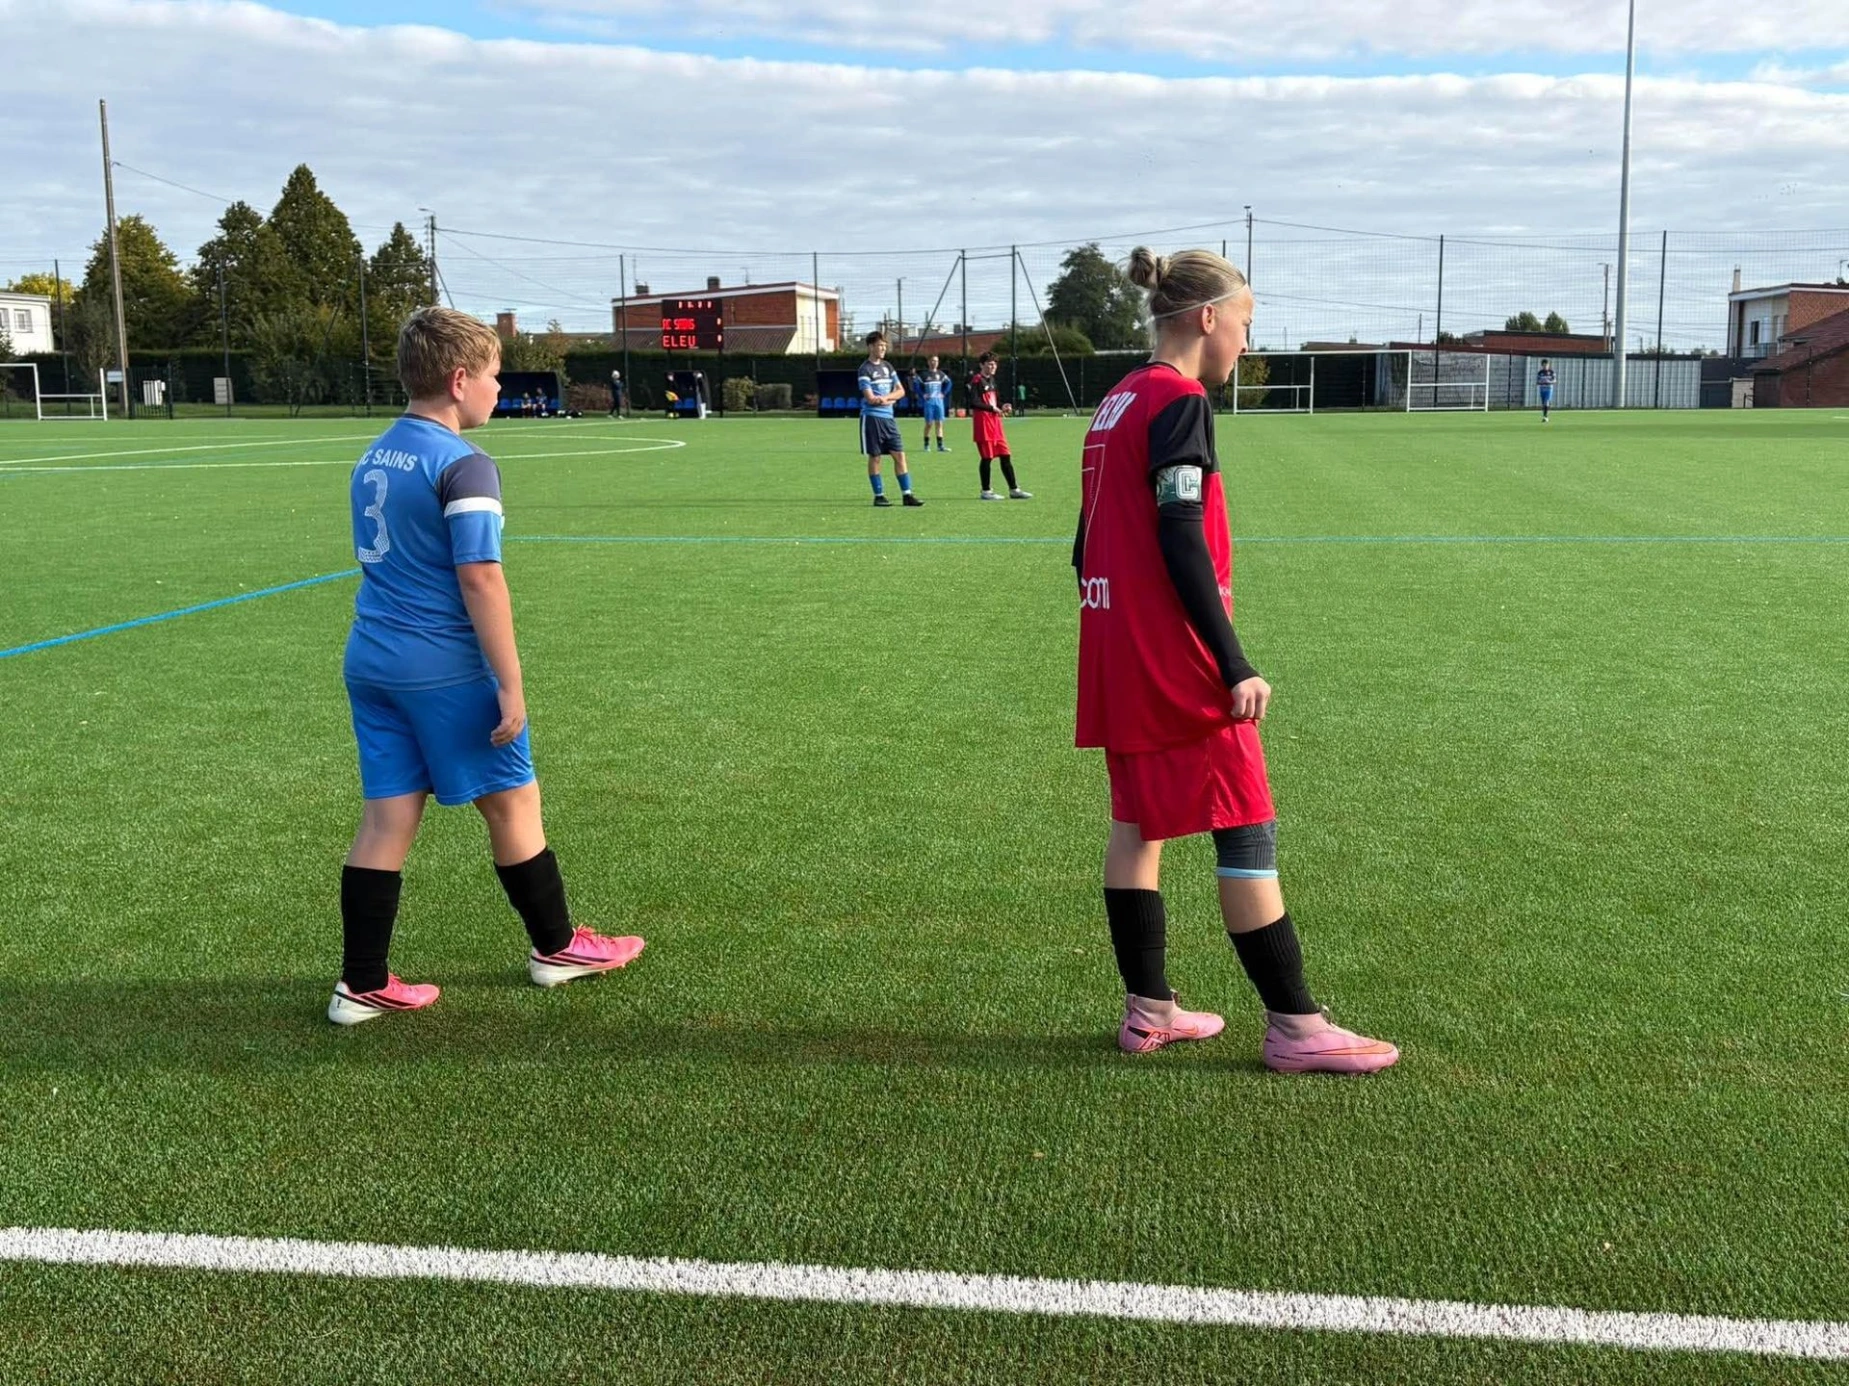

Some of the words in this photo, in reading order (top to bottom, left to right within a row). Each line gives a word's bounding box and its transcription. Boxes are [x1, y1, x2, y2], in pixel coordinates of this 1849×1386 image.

[663, 335, 696, 348] ELEU
[372, 448, 418, 471] SAINS
[1176, 467, 1199, 499] C
[358, 469, 390, 563] 3
